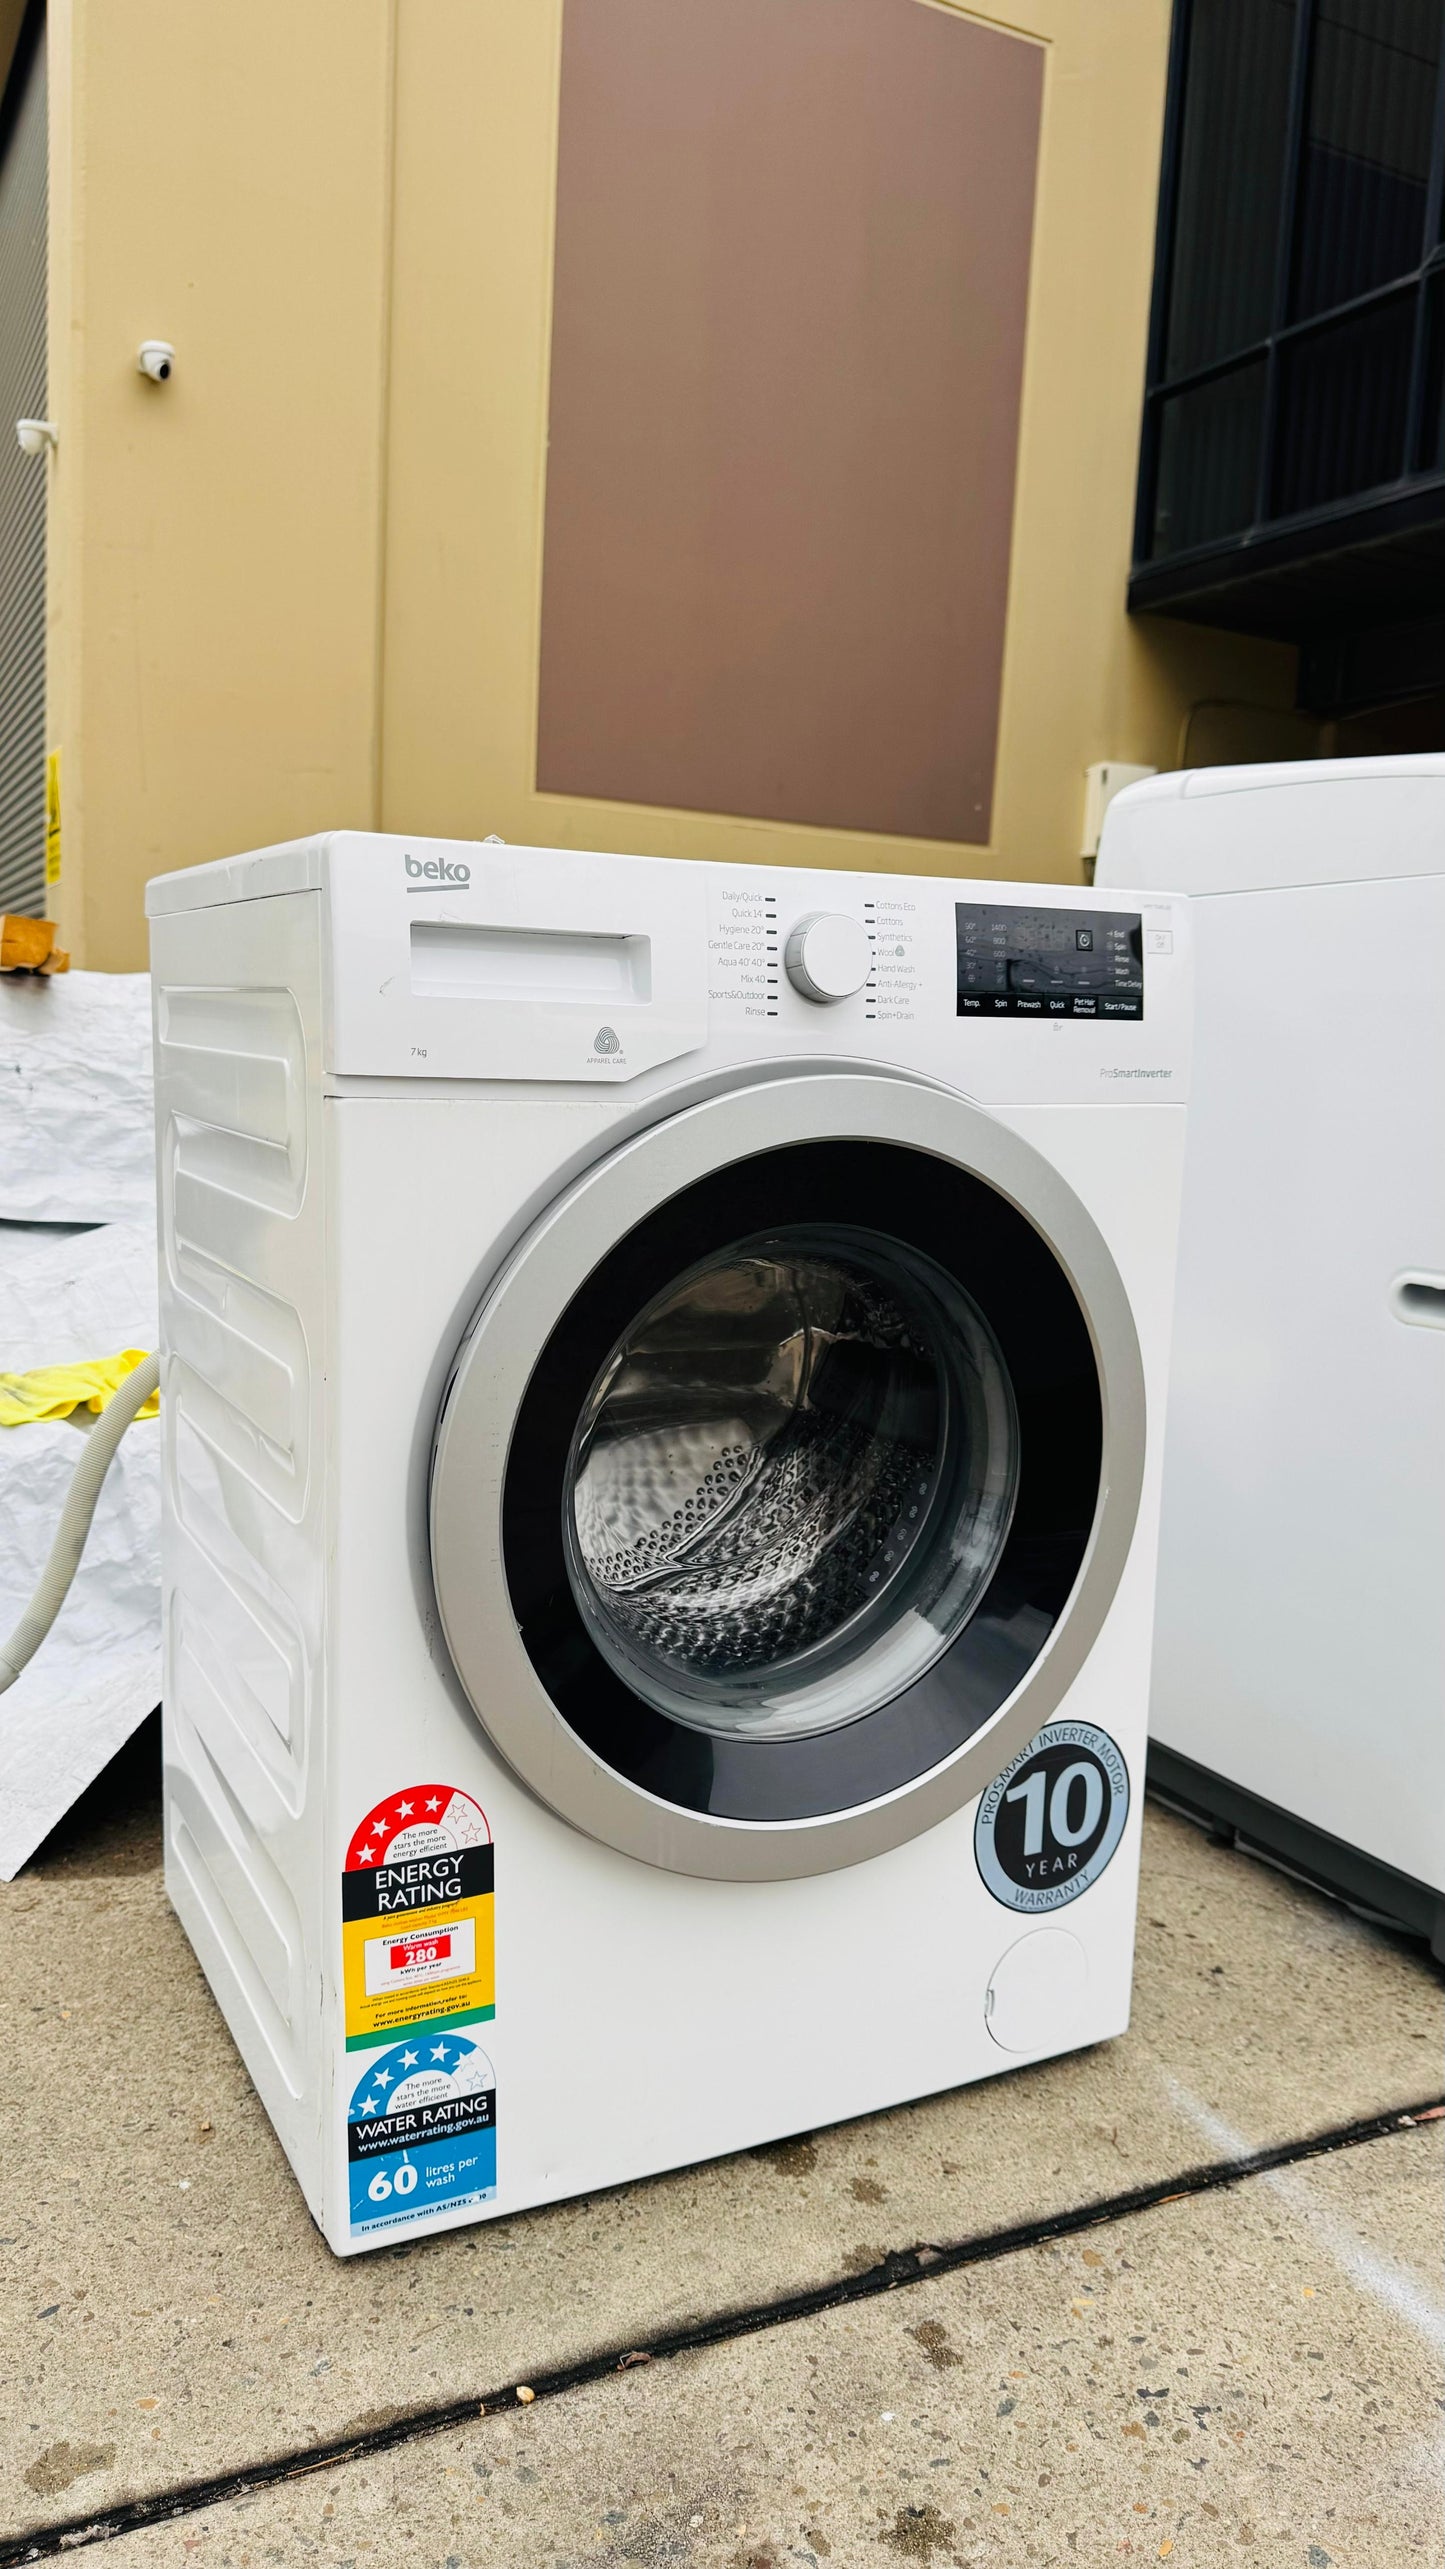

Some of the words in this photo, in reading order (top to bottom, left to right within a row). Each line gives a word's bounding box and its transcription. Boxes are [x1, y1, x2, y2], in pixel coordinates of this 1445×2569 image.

[405, 854, 470, 882] beko
[722, 891, 762, 902] Daily/Quick
[876, 900, 902, 910] Cottons
[904, 903, 916, 911] Eco
[732, 908, 751, 918] Quick
[877, 916, 903, 926] Cottons
[719, 924, 750, 935] Hygiene
[1114, 930, 1125, 938] End
[877, 932, 912, 942] Synthetics
[708, 940, 732, 949] Gentle
[734, 941, 750, 950] Care
[1114, 943, 1126, 951] Spin
[878, 948, 894, 956] Wool
[718, 958, 737, 968] Aqua
[878, 964, 896, 972] Hand
[897, 965, 915, 973] Wash
[741, 975, 753, 983] Mix
[754, 975, 765, 983] 40
[878, 980, 917, 991] Anti-Allergy
[708, 990, 765, 1000] Sports&Outdoor
[878, 996, 894, 1004] Dark
[894, 996, 910, 1004] Care
[964, 999, 980, 1007] Temp.
[994, 1000, 1007, 1008] Spin
[1017, 1000, 1041, 1009] Prewash
[1050, 1001, 1065, 1009] Quick
[1085, 998, 1096, 1006] Hair
[745, 1006, 766, 1016] Rinse
[1073, 1006, 1096, 1014] Removal
[410, 1048, 416, 1056] 7
[417, 1048, 427, 1058] kg
[1100, 1068, 1172, 1078] ProSmartInverter
[1039, 1728, 1099, 1748] INVERTER
[1098, 1742, 1124, 1796] MOTOR
[1006, 1761, 1104, 1856] 10
[393, 1850, 417, 1858] energy
[420, 1843, 447, 1853] efficient
[394, 1842, 411, 1850] stars
[1026, 1853, 1078, 1878] YEAR
[376, 1855, 464, 1890] ENERGY
[1014, 1870, 1090, 1906] WARRANTY
[378, 1878, 462, 1912] RATING
[382, 1937, 408, 1946] Energy
[410, 1926, 459, 1940] Consumption
[403, 1942, 422, 1951] Warm
[424, 1939, 438, 1947] wash
[405, 1947, 437, 1966] 280
[429, 1962, 442, 1970] year
[373, 2002, 470, 2027] www.energyrating.gov.au
[422, 2078, 442, 2086] more
[397, 2093, 414, 2101] stars
[431, 2084, 451, 2092] more
[395, 2100, 416, 2109] water
[419, 2092, 448, 2104] efficient
[356, 2116, 416, 2140] WATER
[423, 2096, 488, 2126] RATING
[358, 2115, 489, 2153] www.waterrating.gov.au
[426, 2162, 455, 2178] litres
[458, 2157, 478, 2173] per
[368, 2164, 418, 2202] 60
[426, 2175, 455, 2189] wash
[371, 2214, 415, 2230] accordance
[417, 2208, 434, 2216] with
[436, 2199, 467, 2213] AS/NZS
